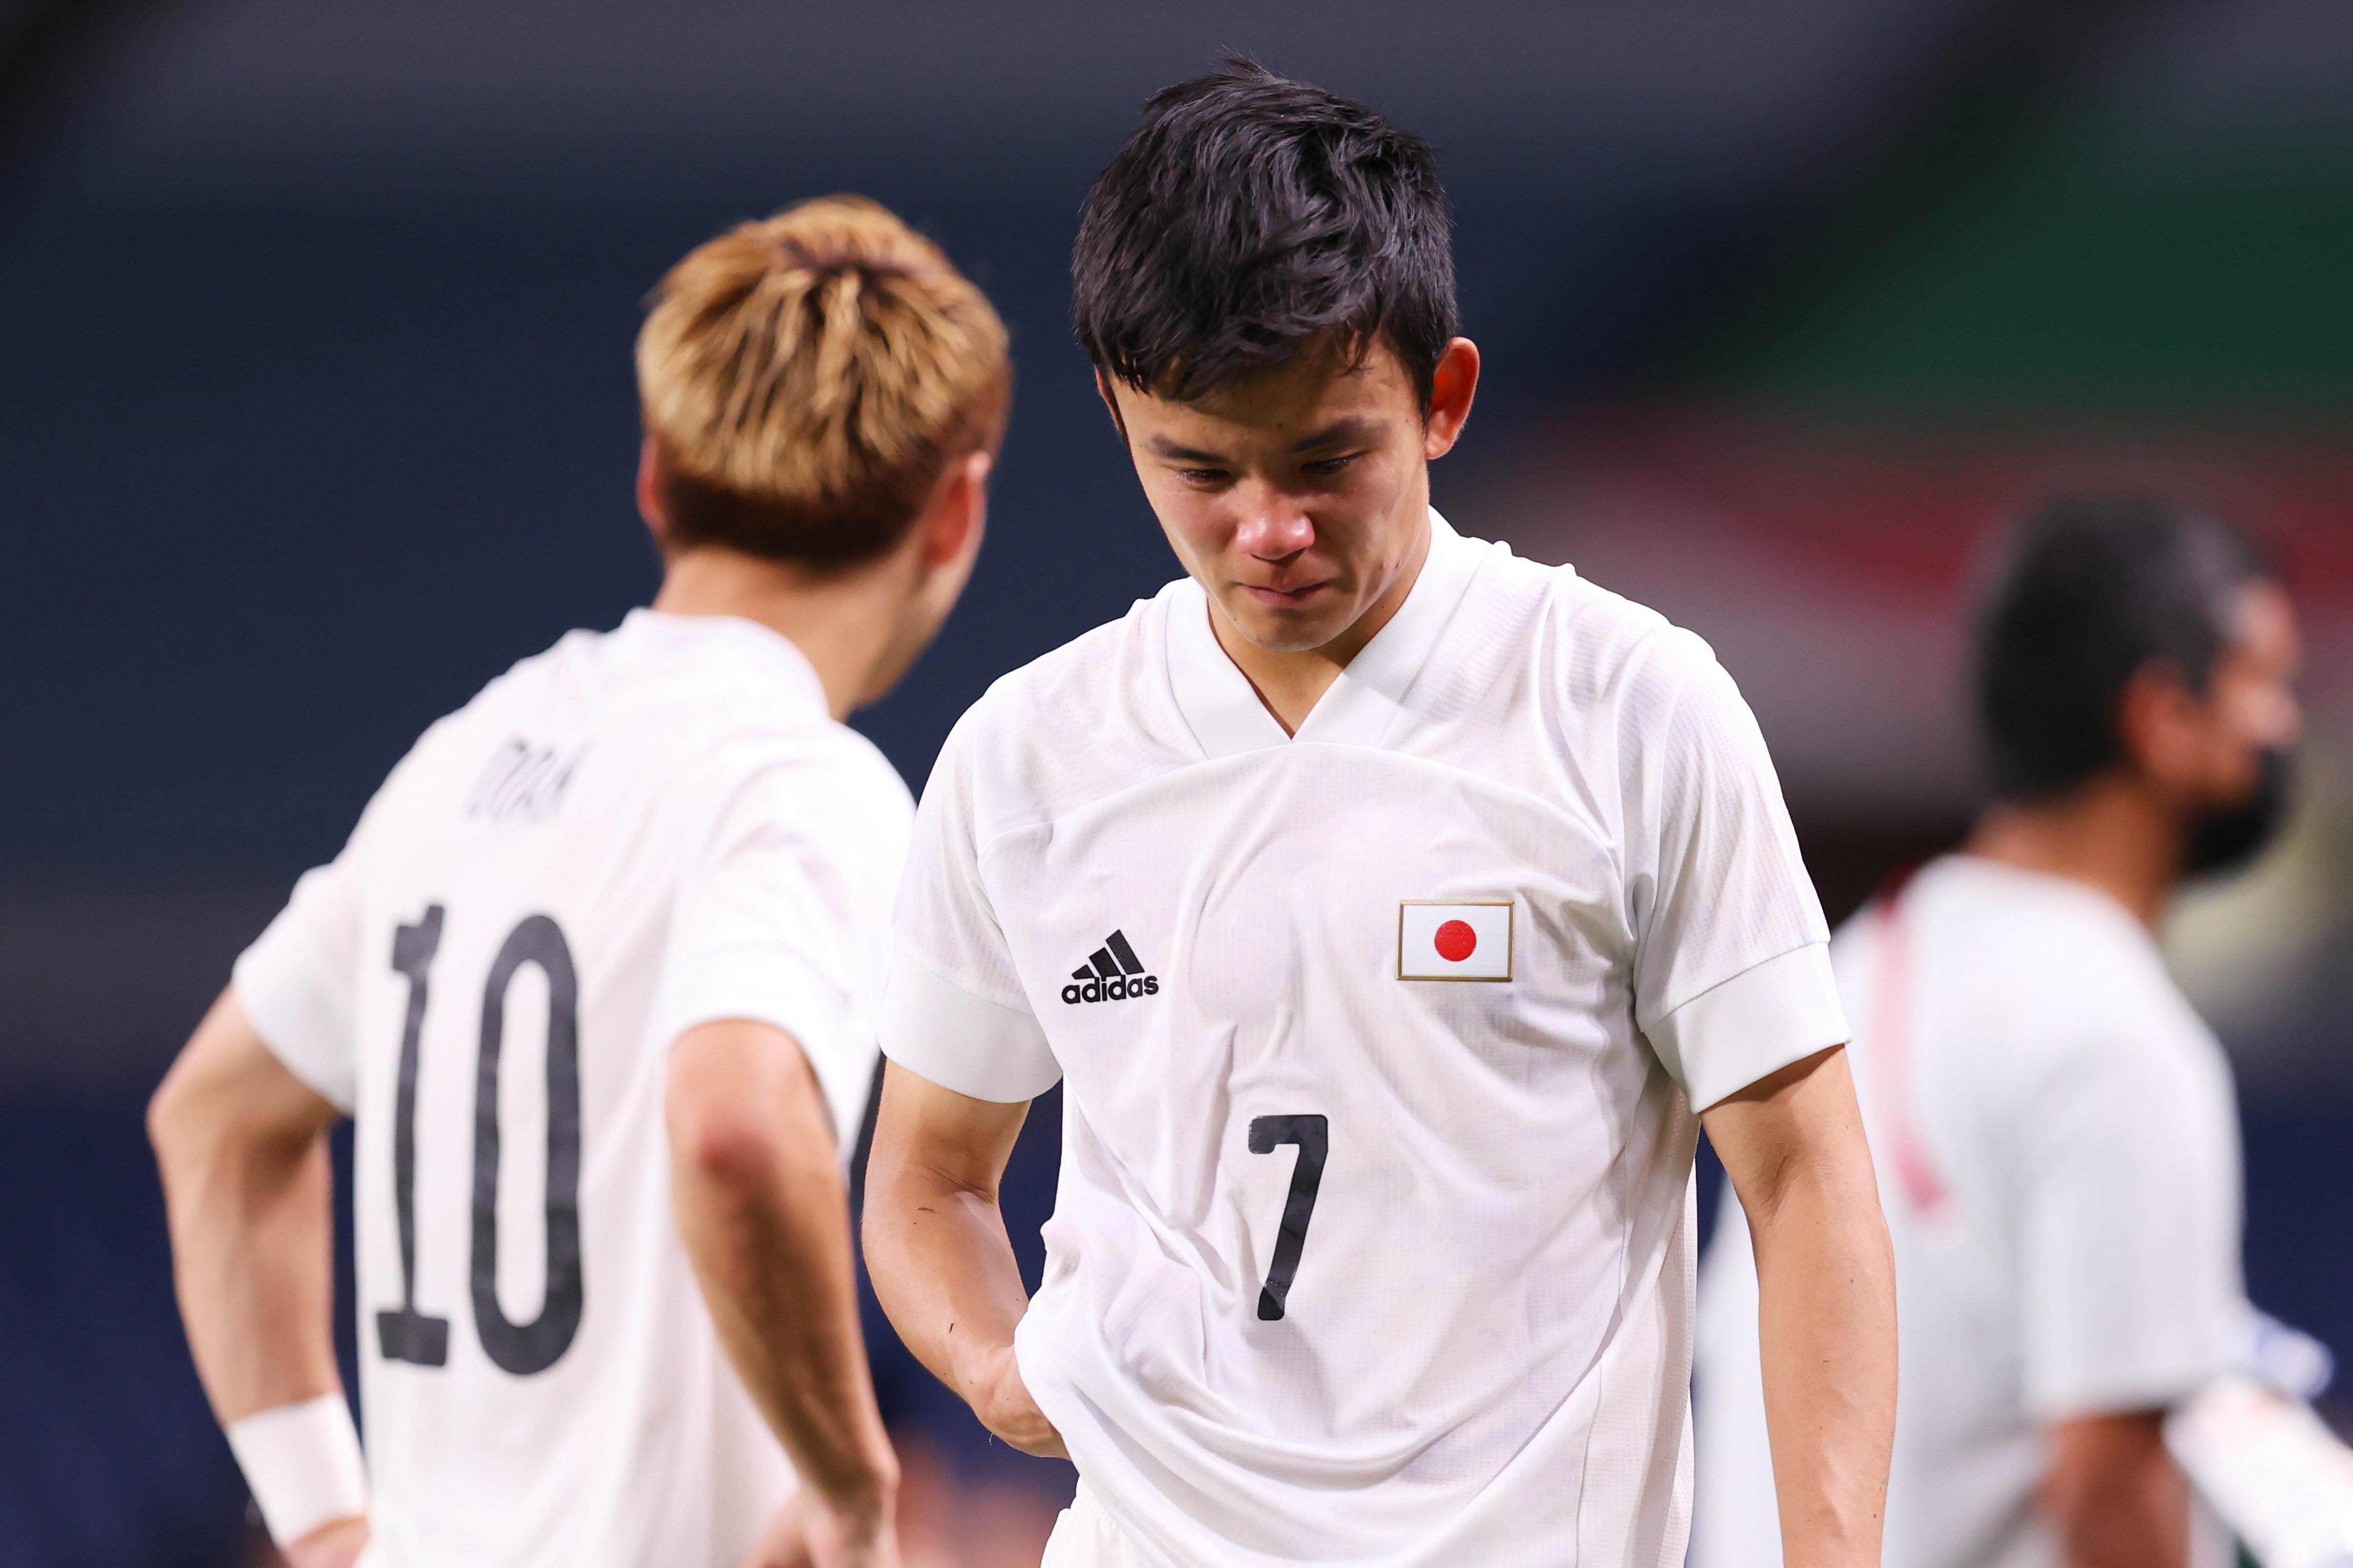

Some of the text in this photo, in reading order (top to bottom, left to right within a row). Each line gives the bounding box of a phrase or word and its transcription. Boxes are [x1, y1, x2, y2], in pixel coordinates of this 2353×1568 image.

[1061, 974, 1159, 1005] adidas
[377, 905, 584, 1375] 10
[1248, 1114, 1329, 1321] 7
